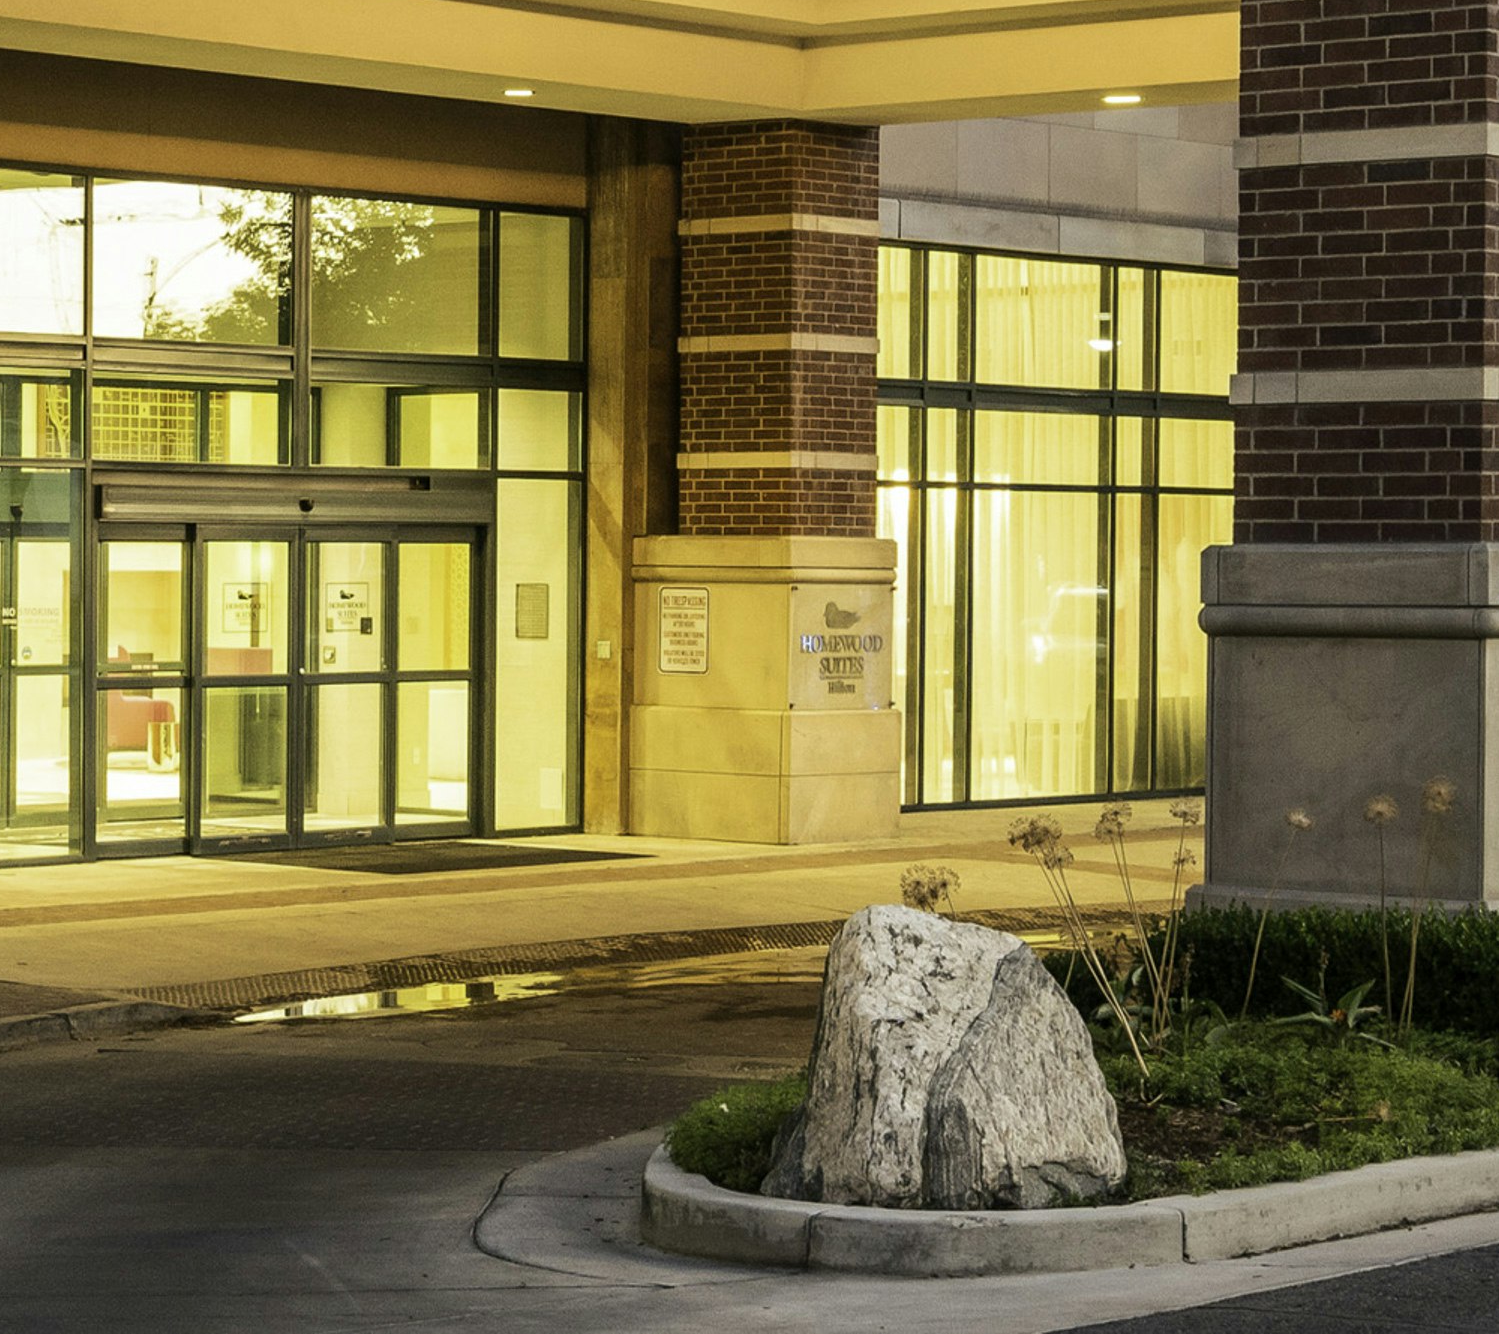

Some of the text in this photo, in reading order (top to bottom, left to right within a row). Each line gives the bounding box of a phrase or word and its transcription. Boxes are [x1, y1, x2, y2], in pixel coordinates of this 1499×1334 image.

[2, 607, 16, 617] NO
[801, 634, 883, 654] HOMEWOOD
[819, 656, 864, 674] SUITES
